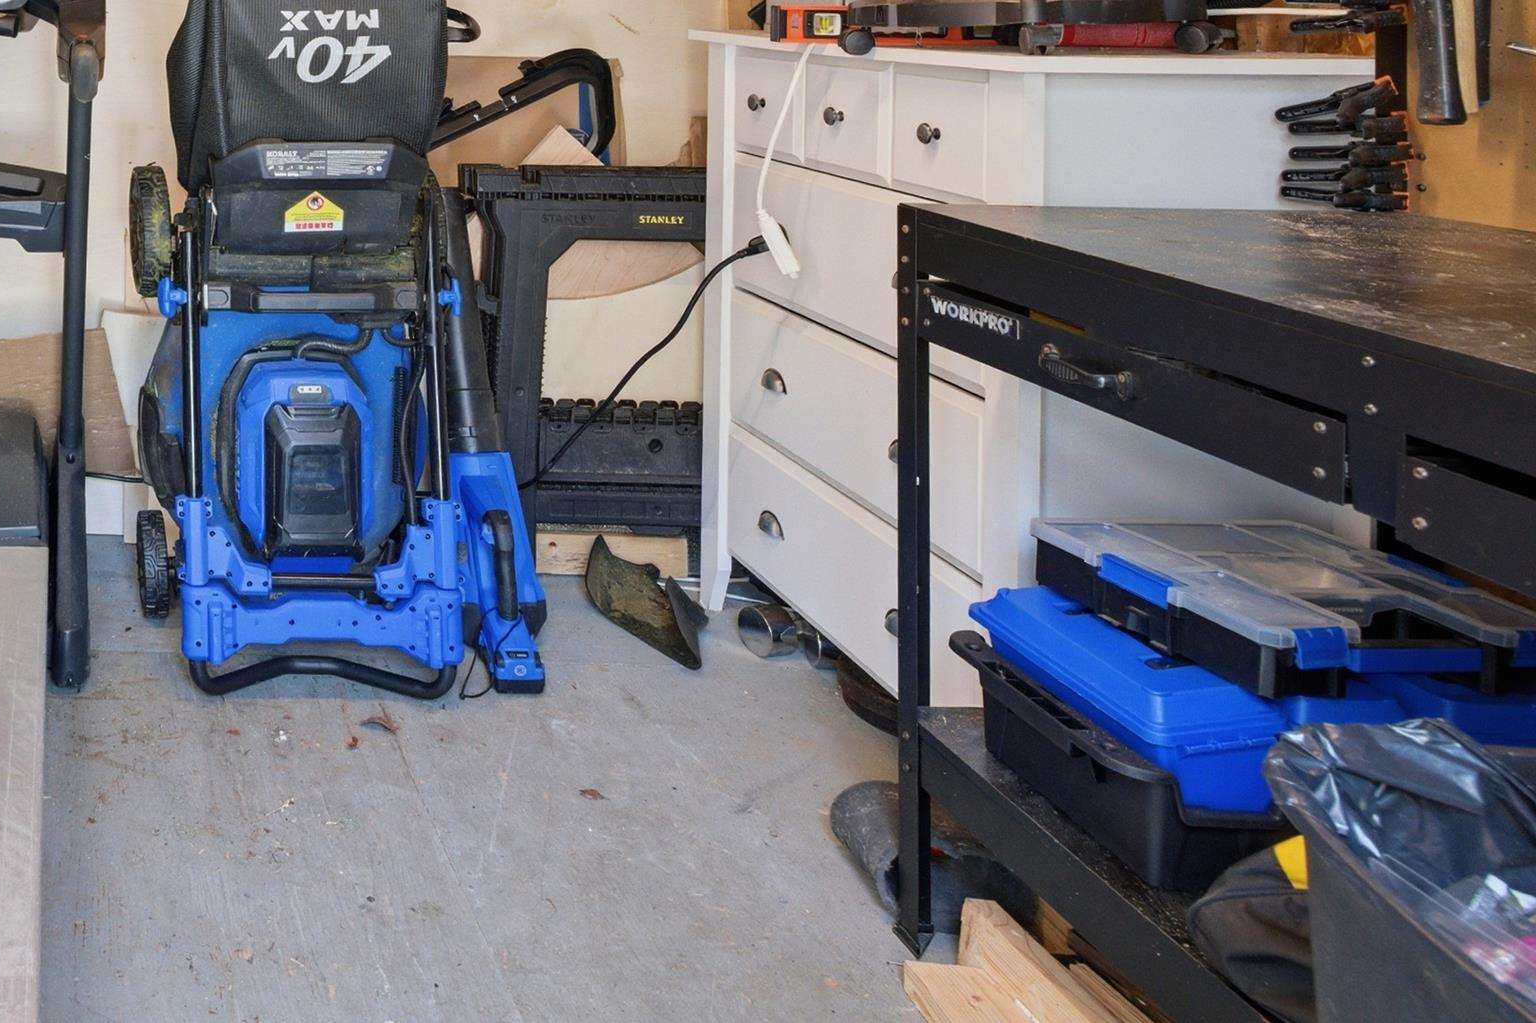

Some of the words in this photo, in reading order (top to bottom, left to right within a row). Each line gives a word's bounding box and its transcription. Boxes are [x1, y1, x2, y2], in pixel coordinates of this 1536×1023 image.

[280, 9, 380, 31] MAX
[268, 36, 392, 83] 40V
[639, 215, 685, 224] STANLEY
[929, 295, 1009, 335] WORKPRO
